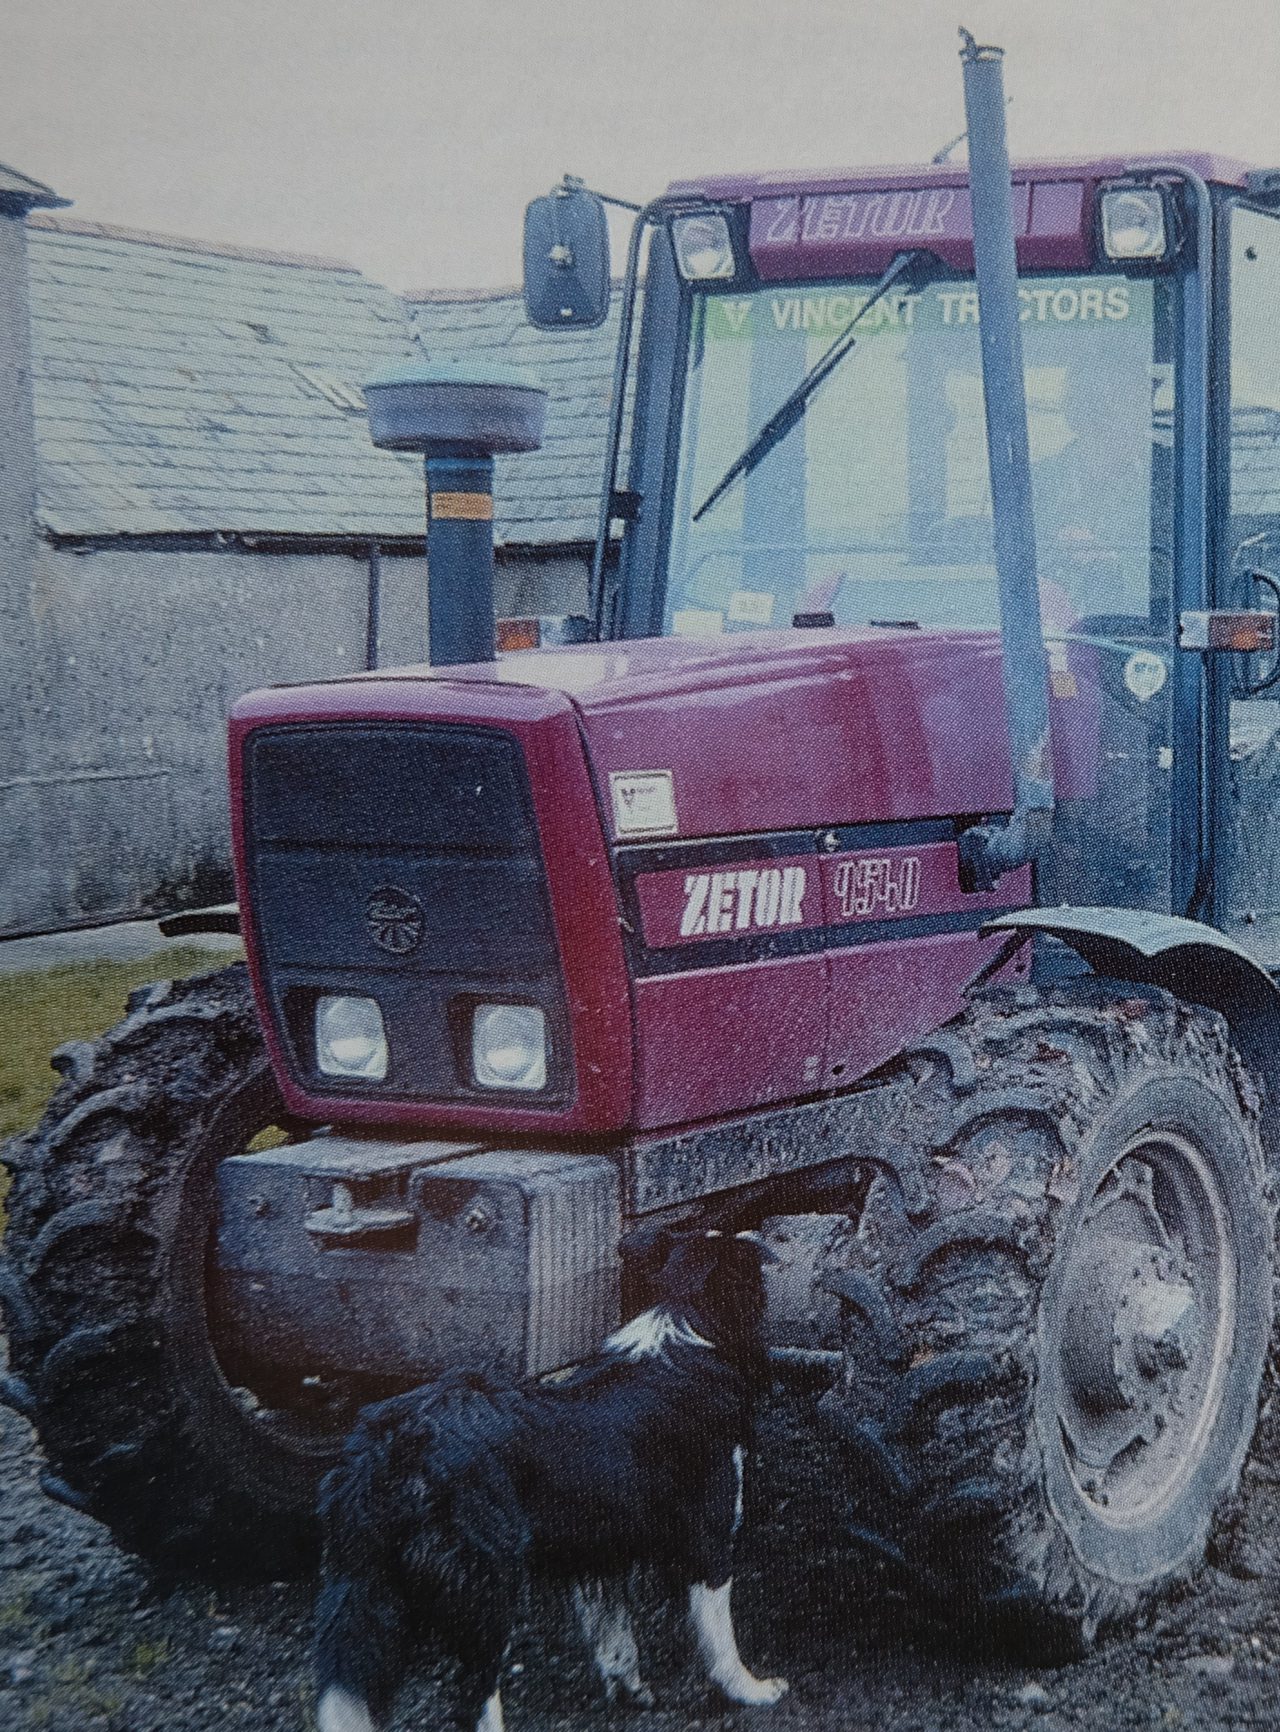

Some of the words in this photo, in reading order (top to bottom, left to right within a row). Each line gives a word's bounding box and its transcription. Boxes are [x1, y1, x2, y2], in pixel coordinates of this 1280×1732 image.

[767, 189, 955, 242] ZETOR
[771, 294, 922, 330] VINCENT
[936, 288, 1130, 324] TRCTORS
[680, 867, 807, 937] ZETOR
[834, 857, 922, 918] 9540
